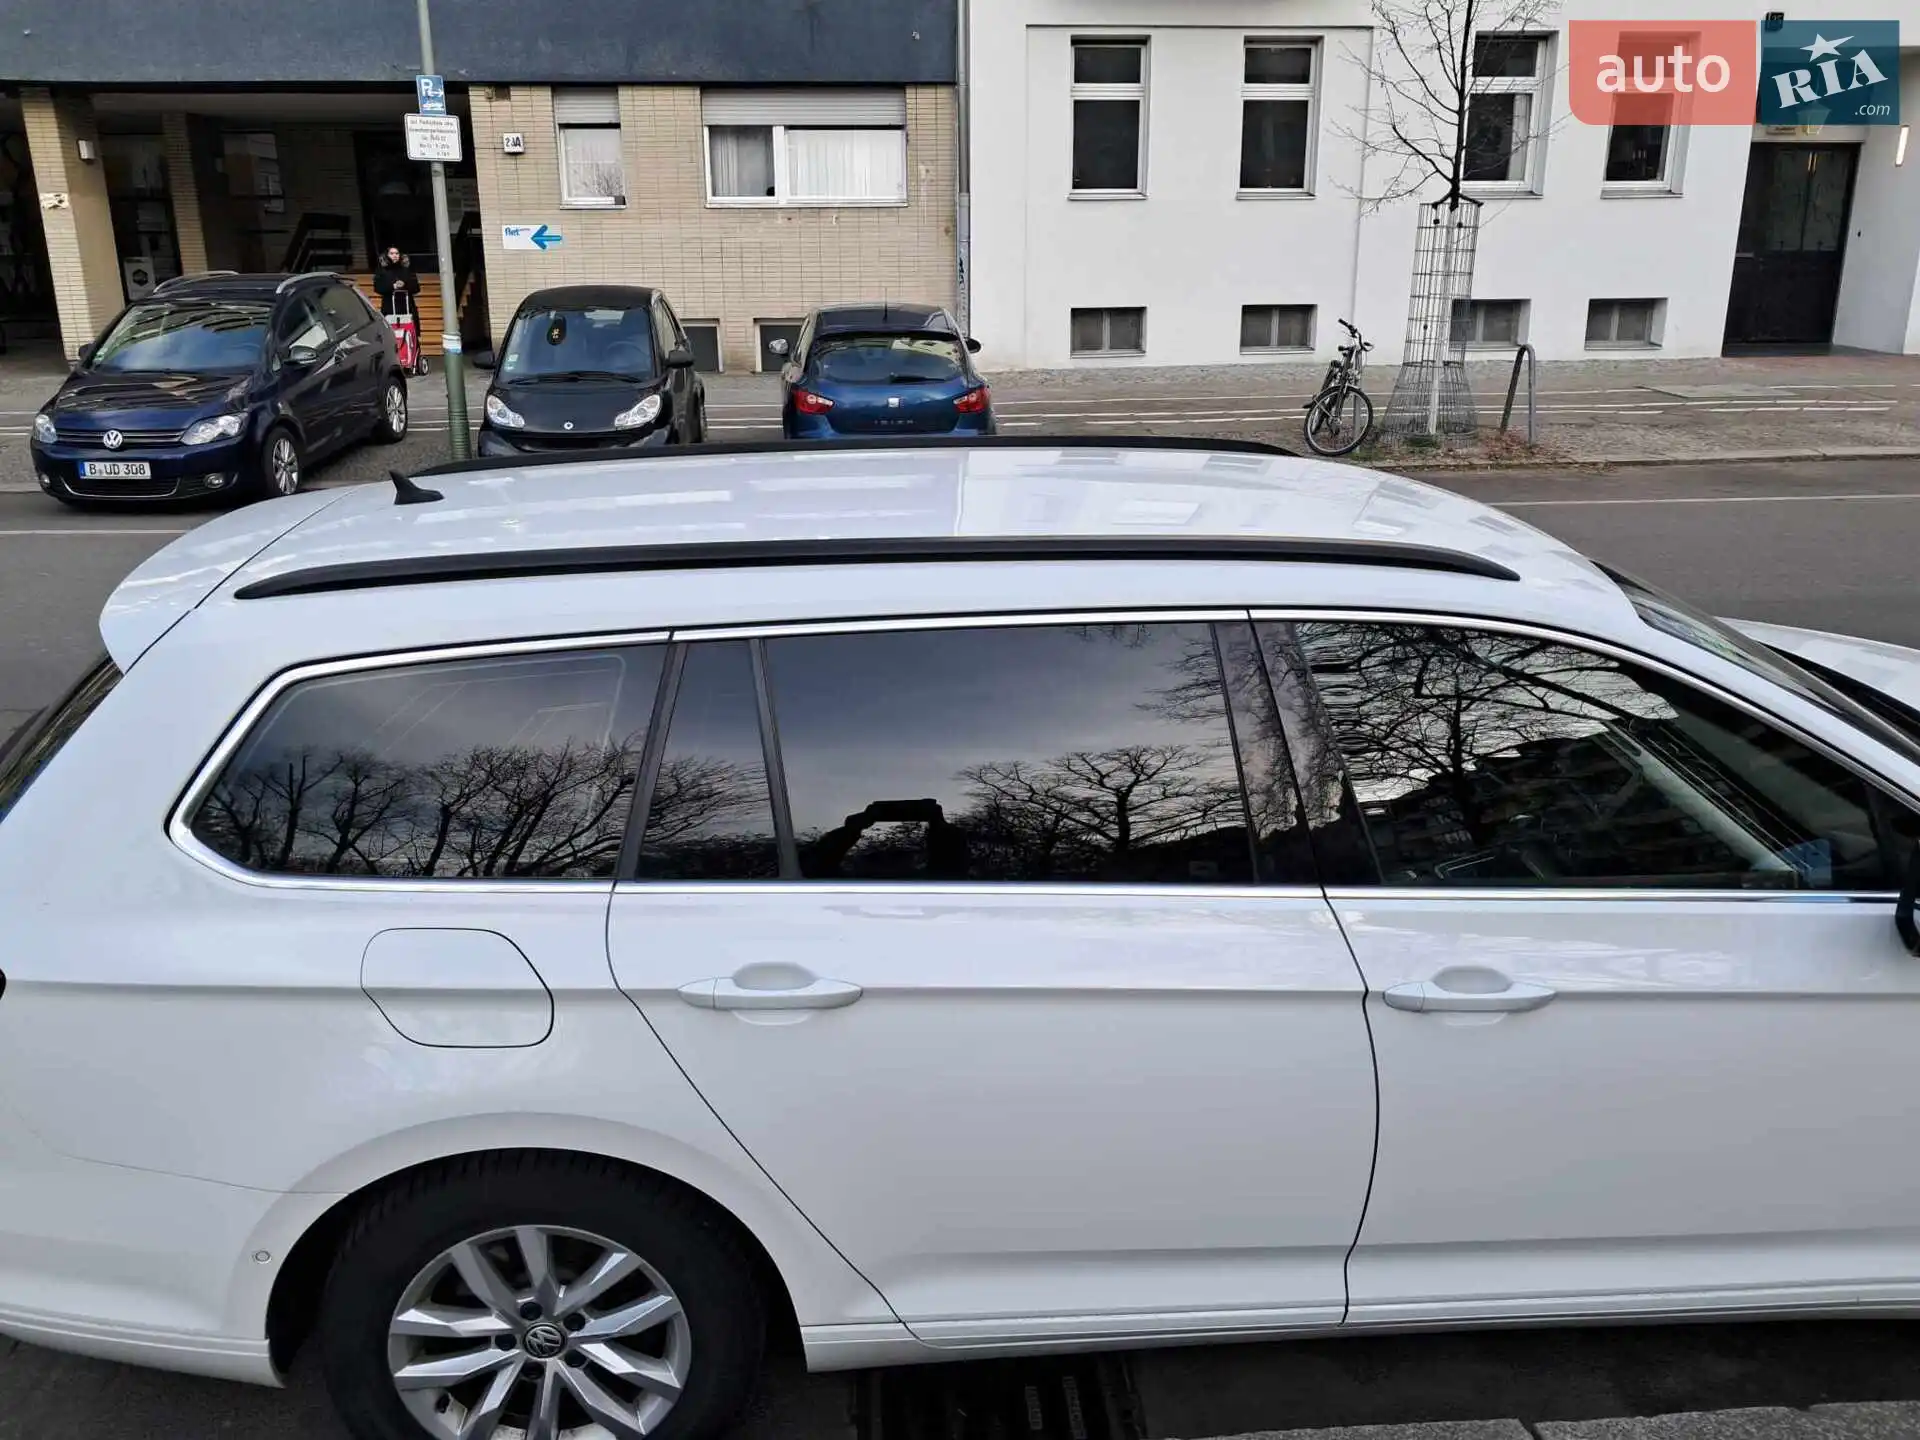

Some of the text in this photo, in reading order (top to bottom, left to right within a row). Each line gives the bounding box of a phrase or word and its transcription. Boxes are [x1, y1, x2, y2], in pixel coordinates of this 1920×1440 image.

[420, 78, 433, 97] P
[88, 463, 146, 475] B UD 308
